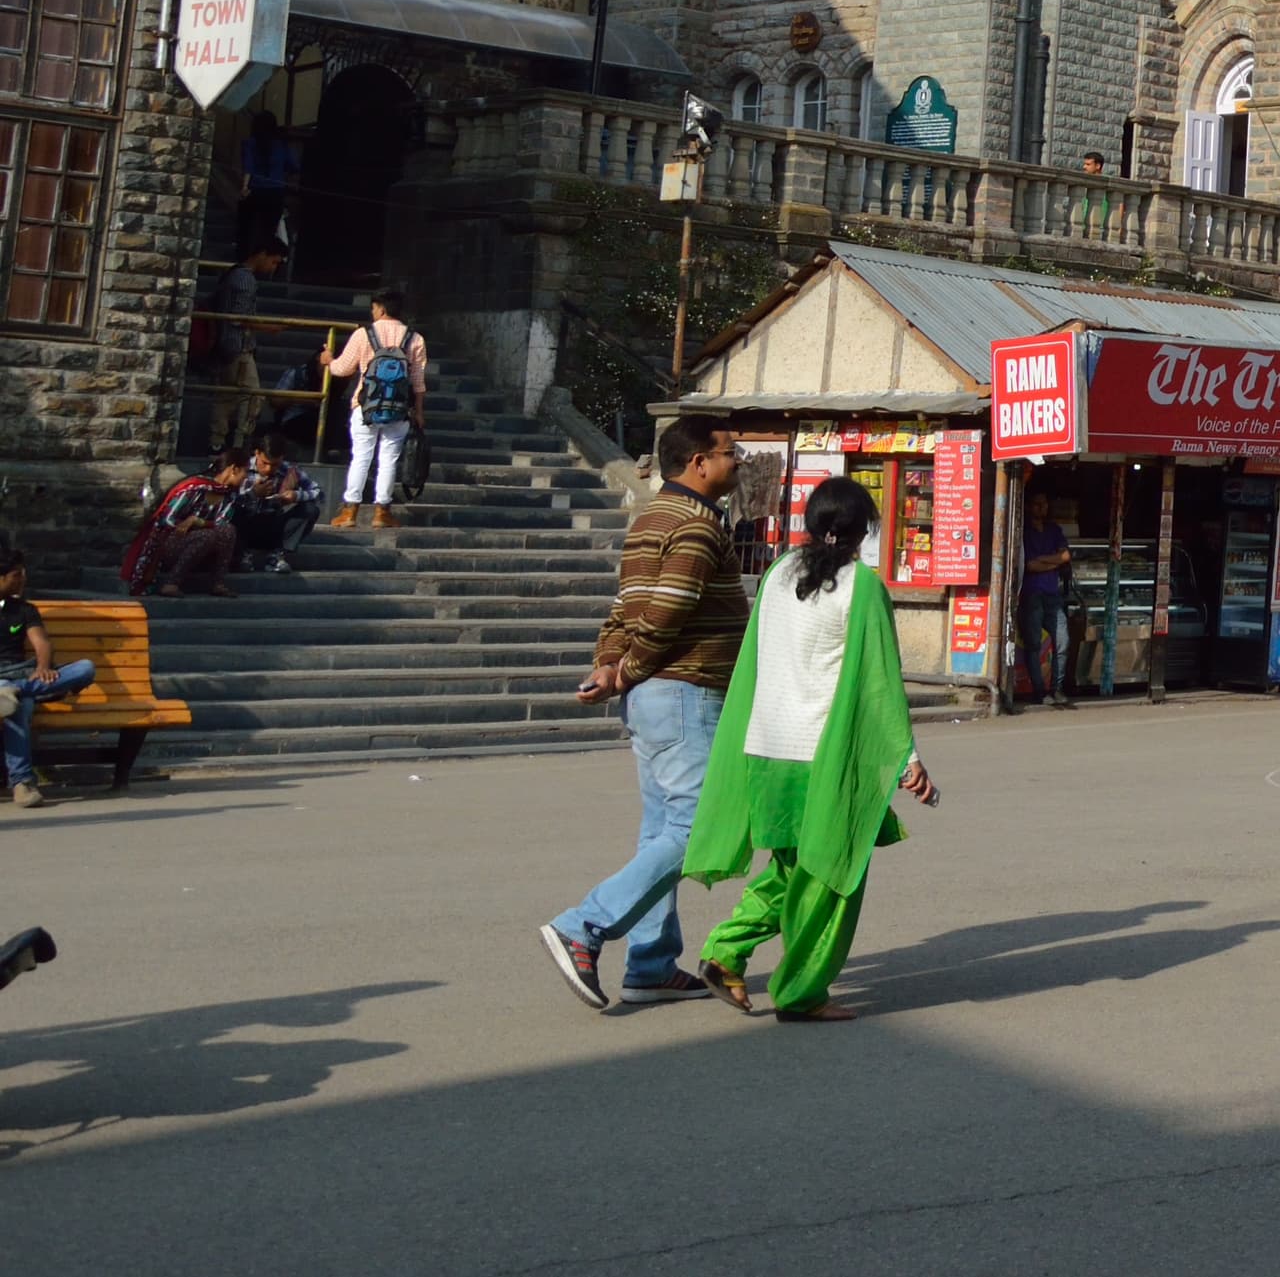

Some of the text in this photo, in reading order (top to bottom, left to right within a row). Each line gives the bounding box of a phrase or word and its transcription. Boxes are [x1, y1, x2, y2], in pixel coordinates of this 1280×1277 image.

[184, 37, 240, 67] HALL
[1005, 354, 1058, 393] RAMA
[1147, 343, 1228, 407] The
[1000, 397, 1066, 438] BAKERS
[1196, 415, 1231, 433] Voice
[1233, 416, 1249, 434] of
[1249, 418, 1270, 434] the
[1171, 439, 1204, 453] Rama
[1207, 440, 1237, 454] News
[1239, 442, 1279, 457] Agency
